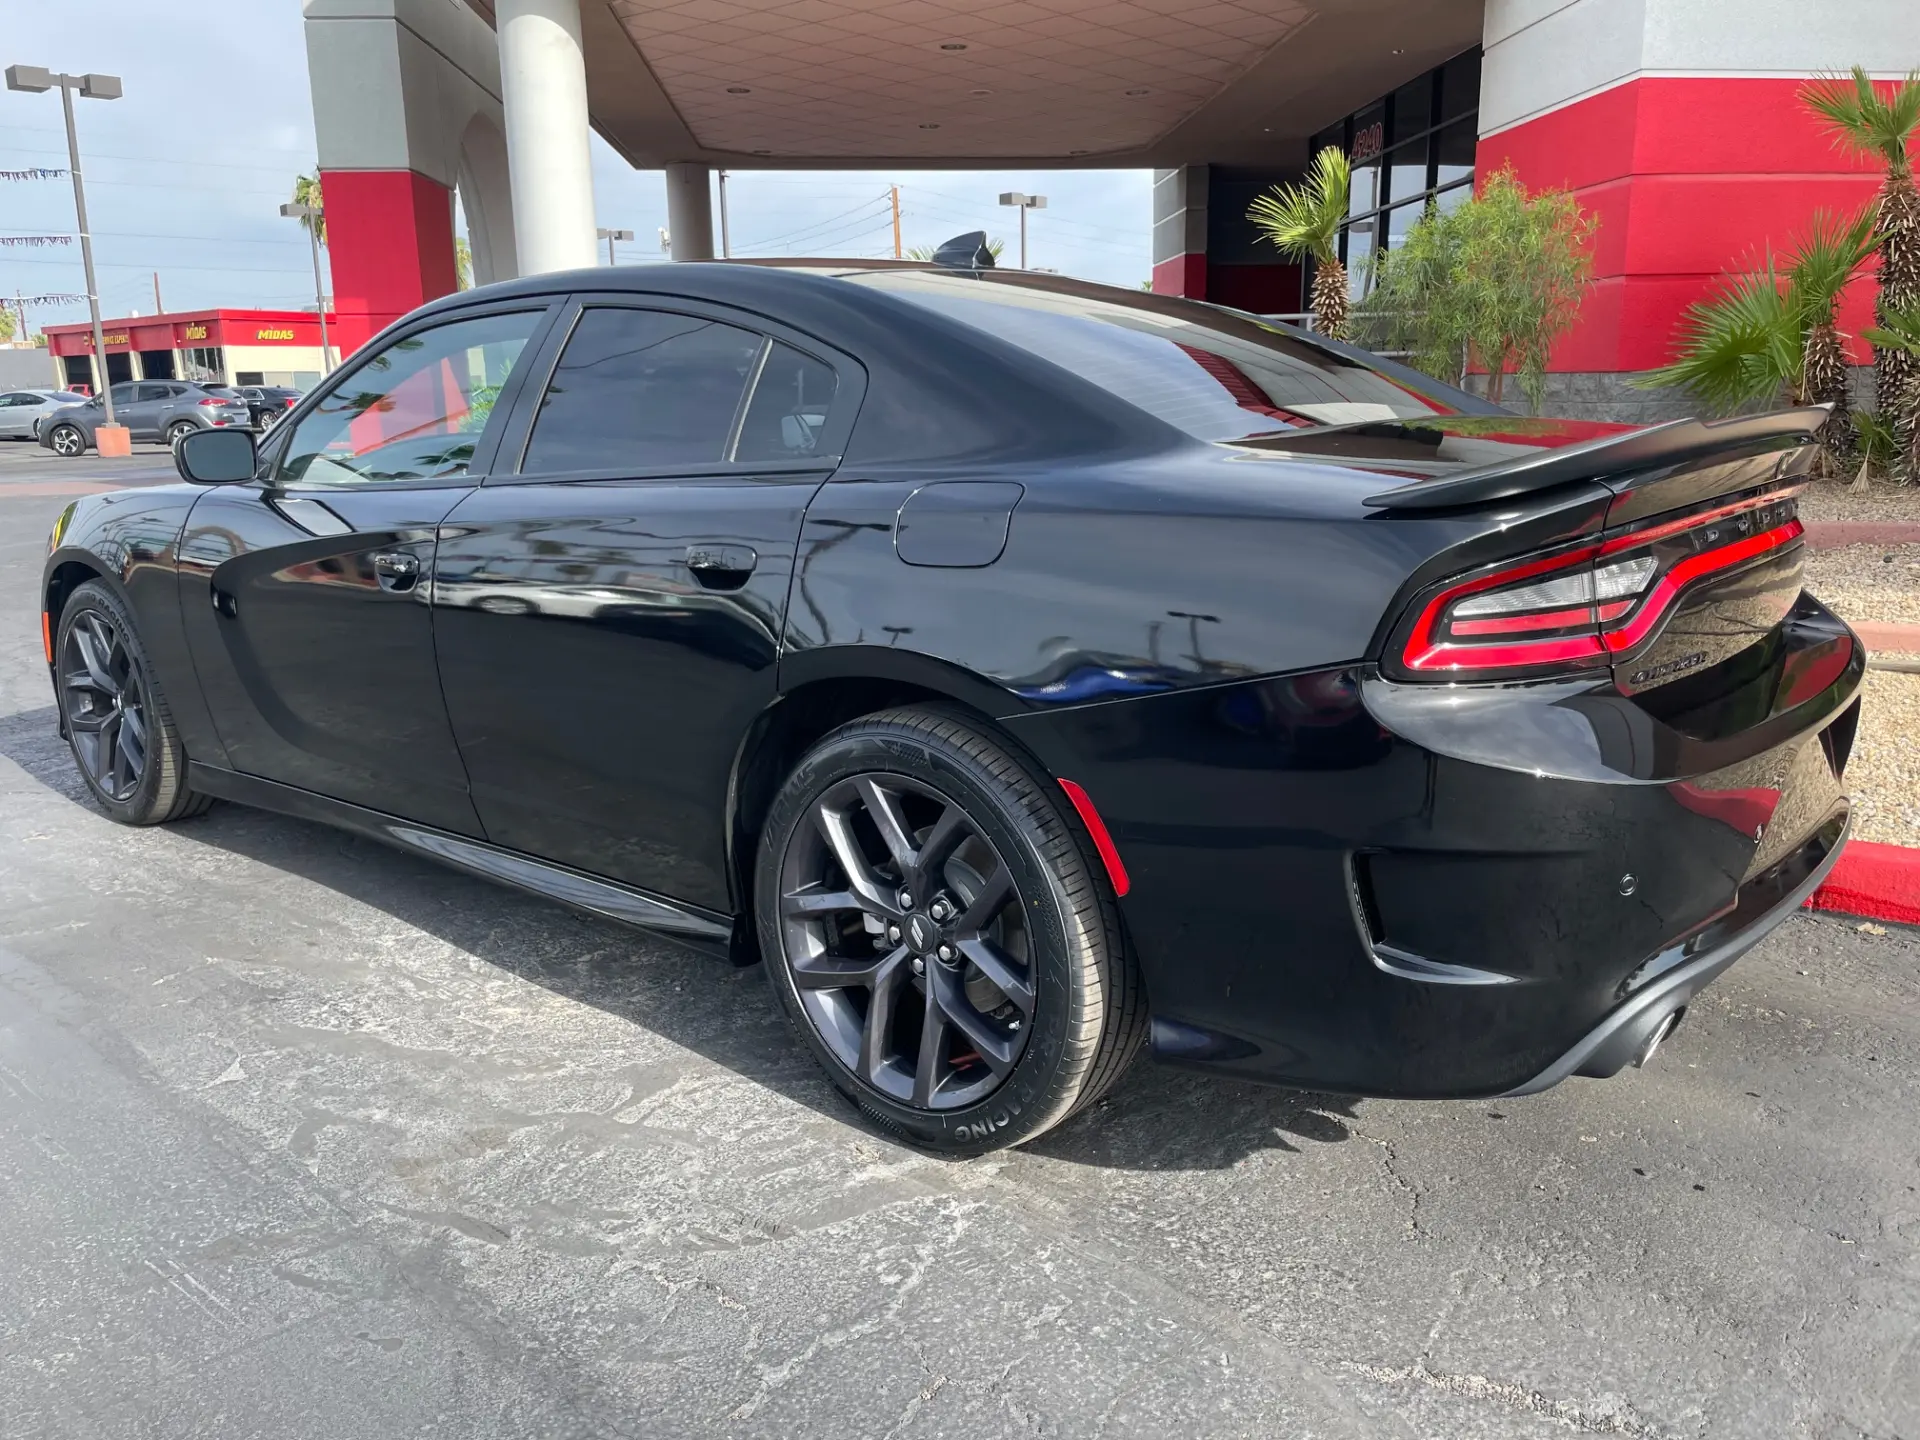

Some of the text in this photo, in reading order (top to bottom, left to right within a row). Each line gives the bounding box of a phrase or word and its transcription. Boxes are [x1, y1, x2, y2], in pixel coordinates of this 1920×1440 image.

[1352, 122, 1382, 159] 4240
[186, 323, 207, 340] MIDAS
[257, 328, 294, 340] MIDAS
